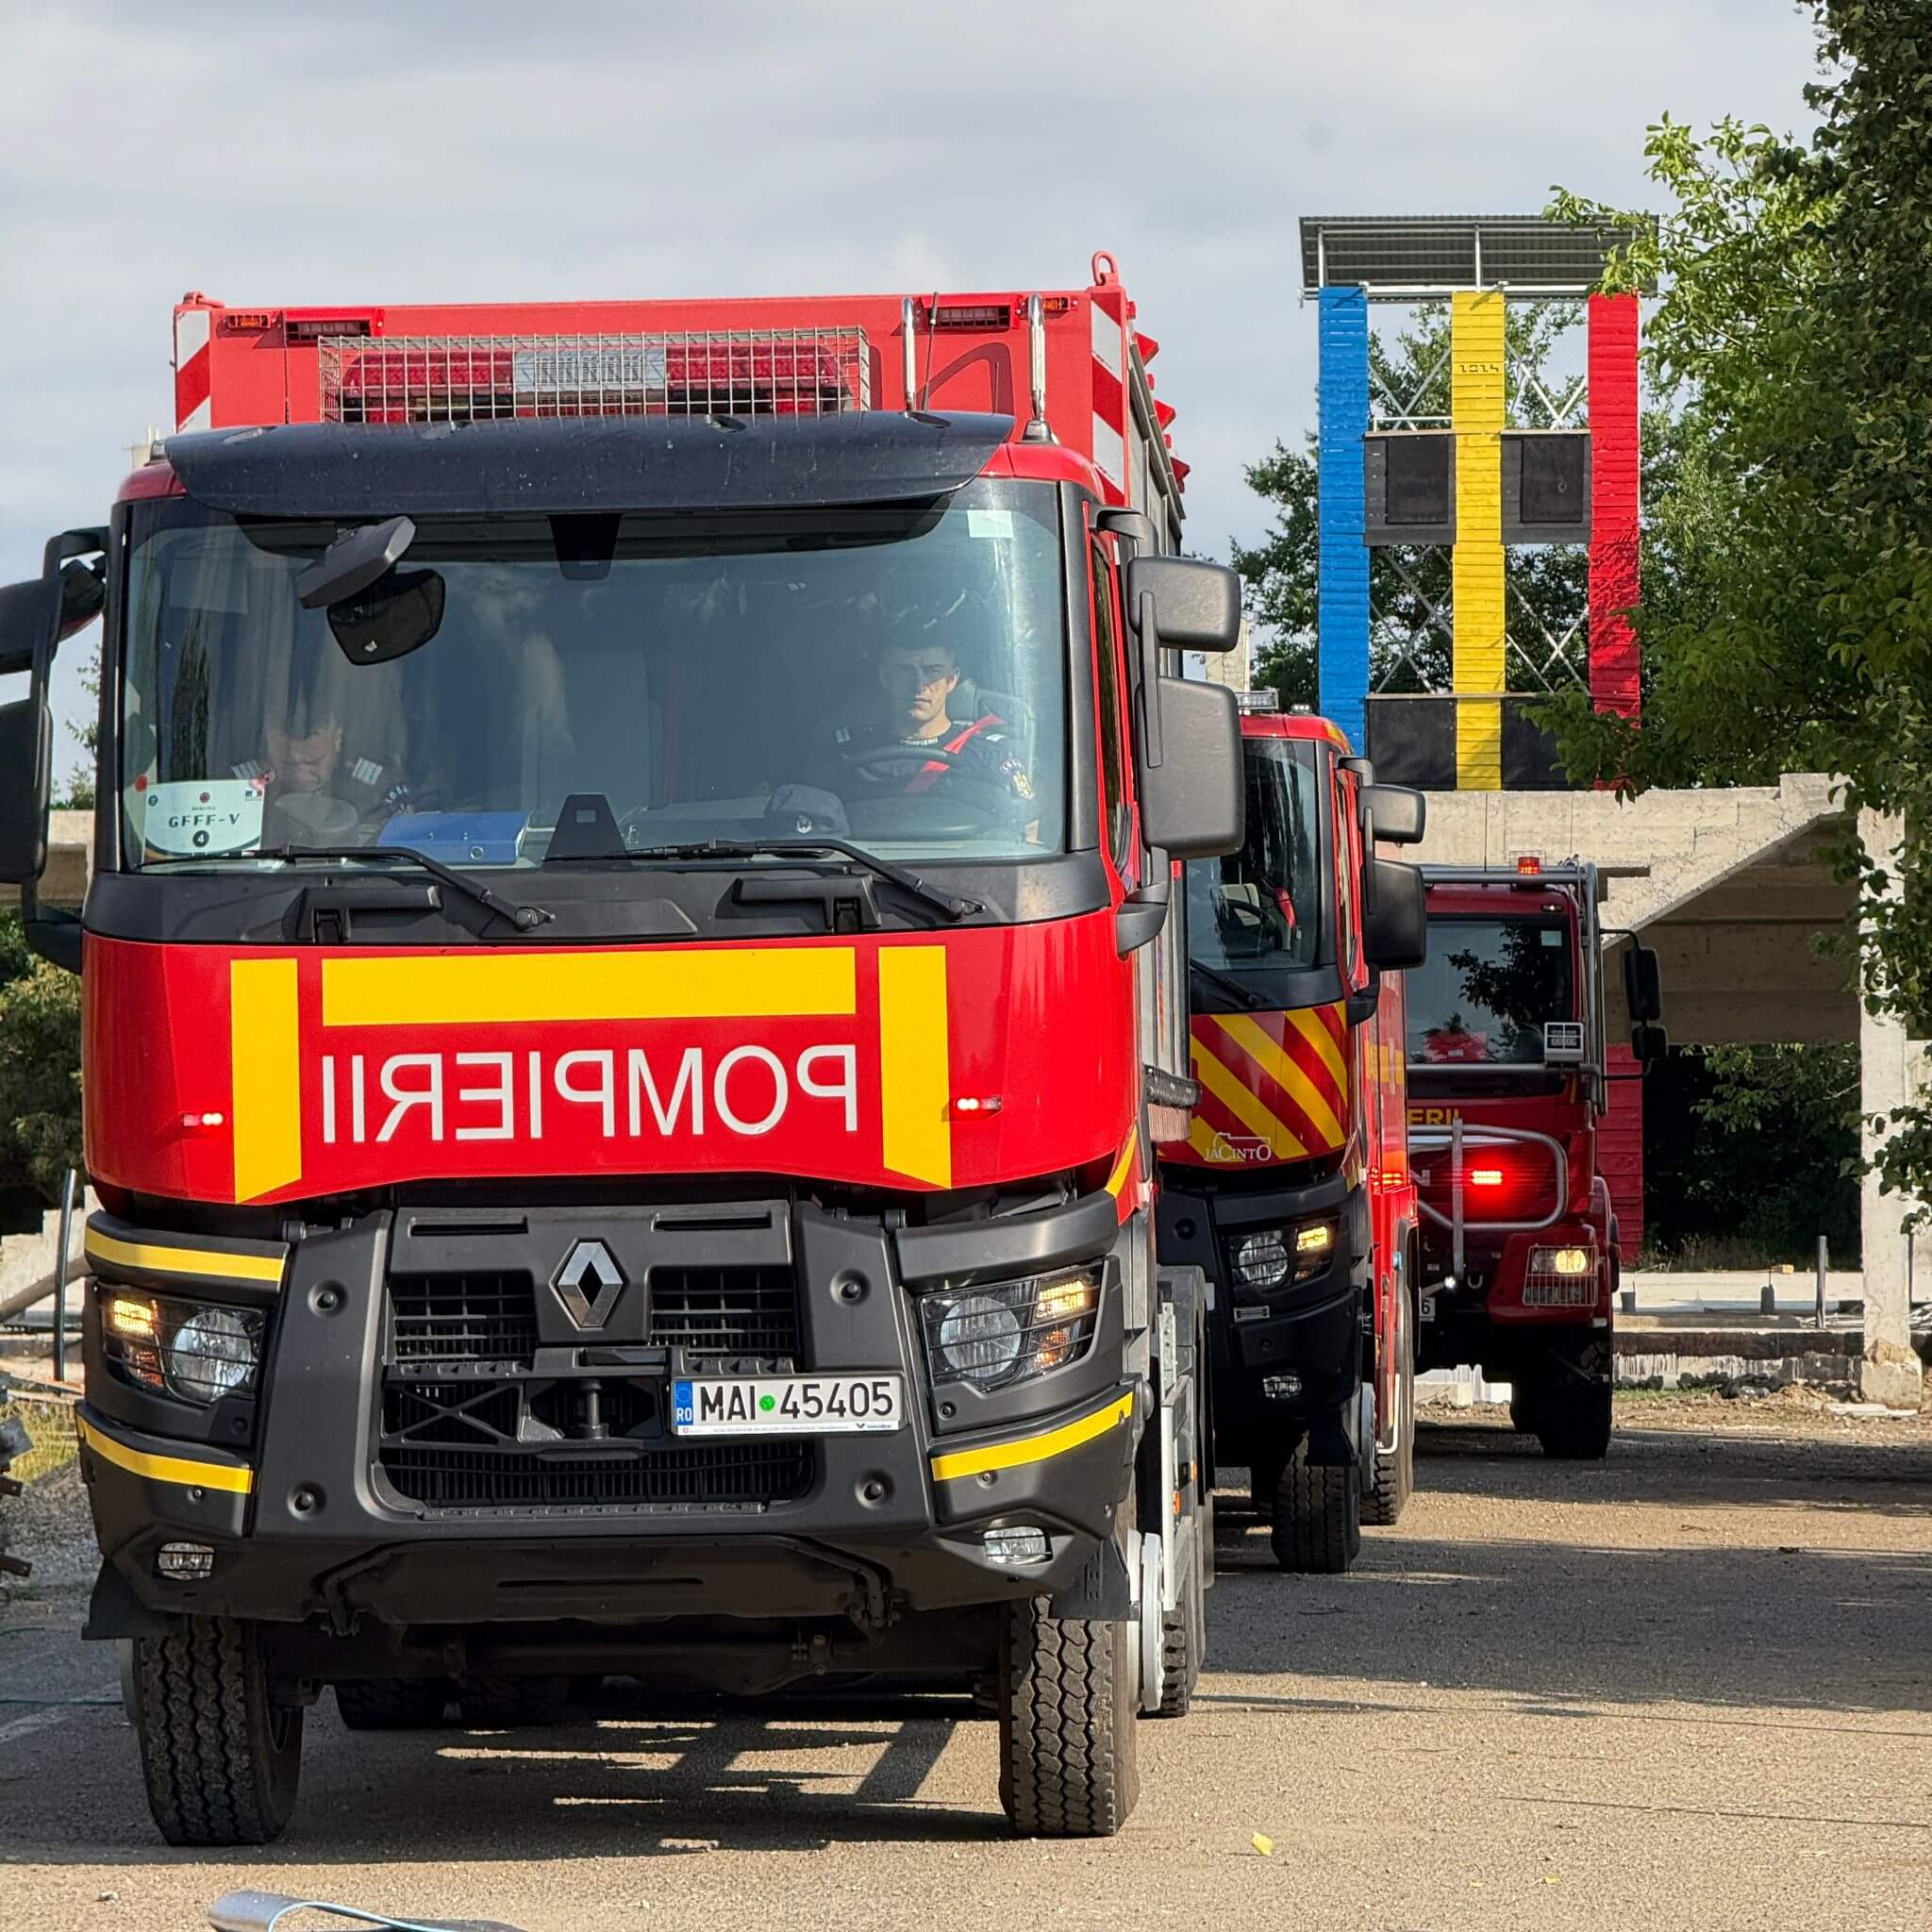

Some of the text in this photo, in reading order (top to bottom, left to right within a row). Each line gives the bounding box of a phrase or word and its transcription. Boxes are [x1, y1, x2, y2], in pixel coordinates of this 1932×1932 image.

[168, 812, 241, 828] GFFF-V
[675, 1381, 893, 1423] RO MAI 45405
